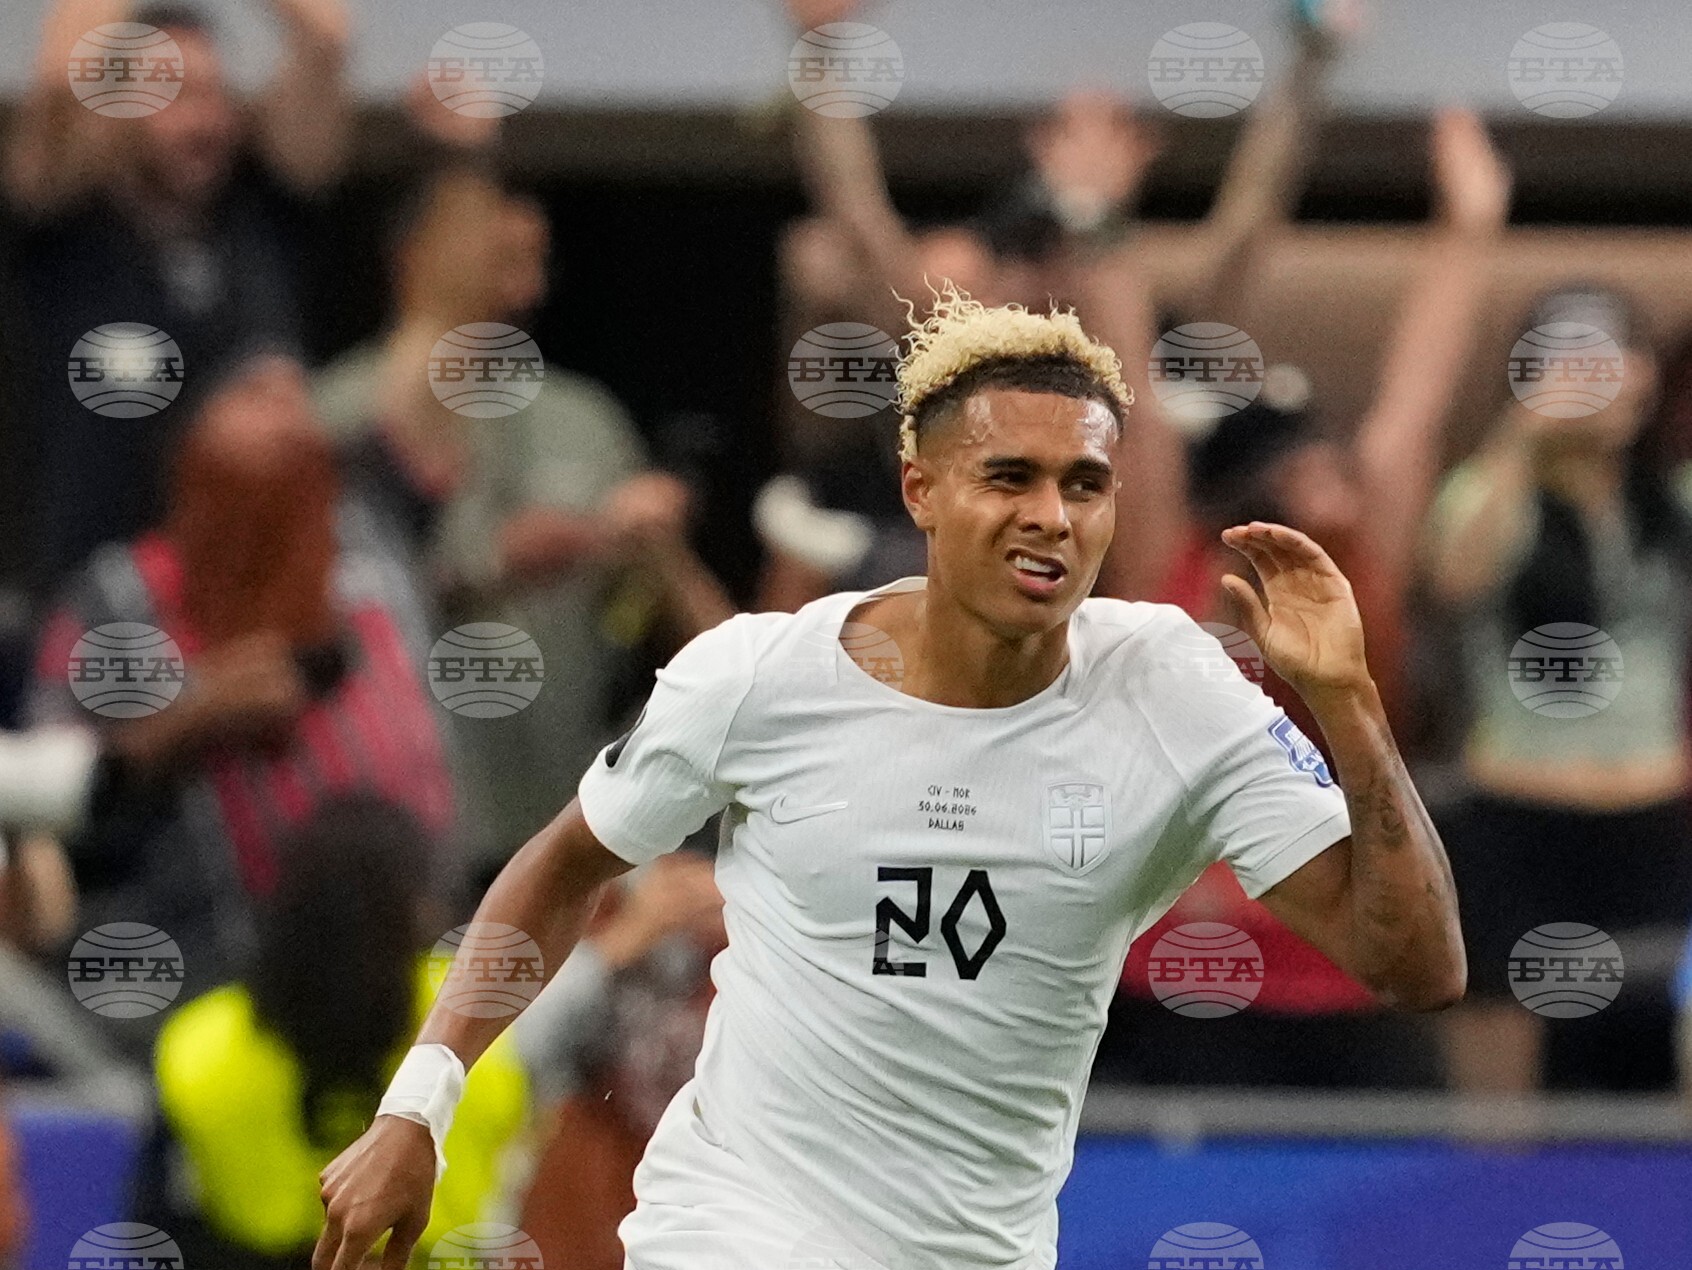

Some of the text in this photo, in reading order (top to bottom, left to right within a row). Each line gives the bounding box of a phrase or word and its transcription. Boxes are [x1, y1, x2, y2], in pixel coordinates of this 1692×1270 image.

[927, 785, 943, 797] CIV
[928, 817, 965, 832] DALLAS
[872, 866, 1007, 981] 20
